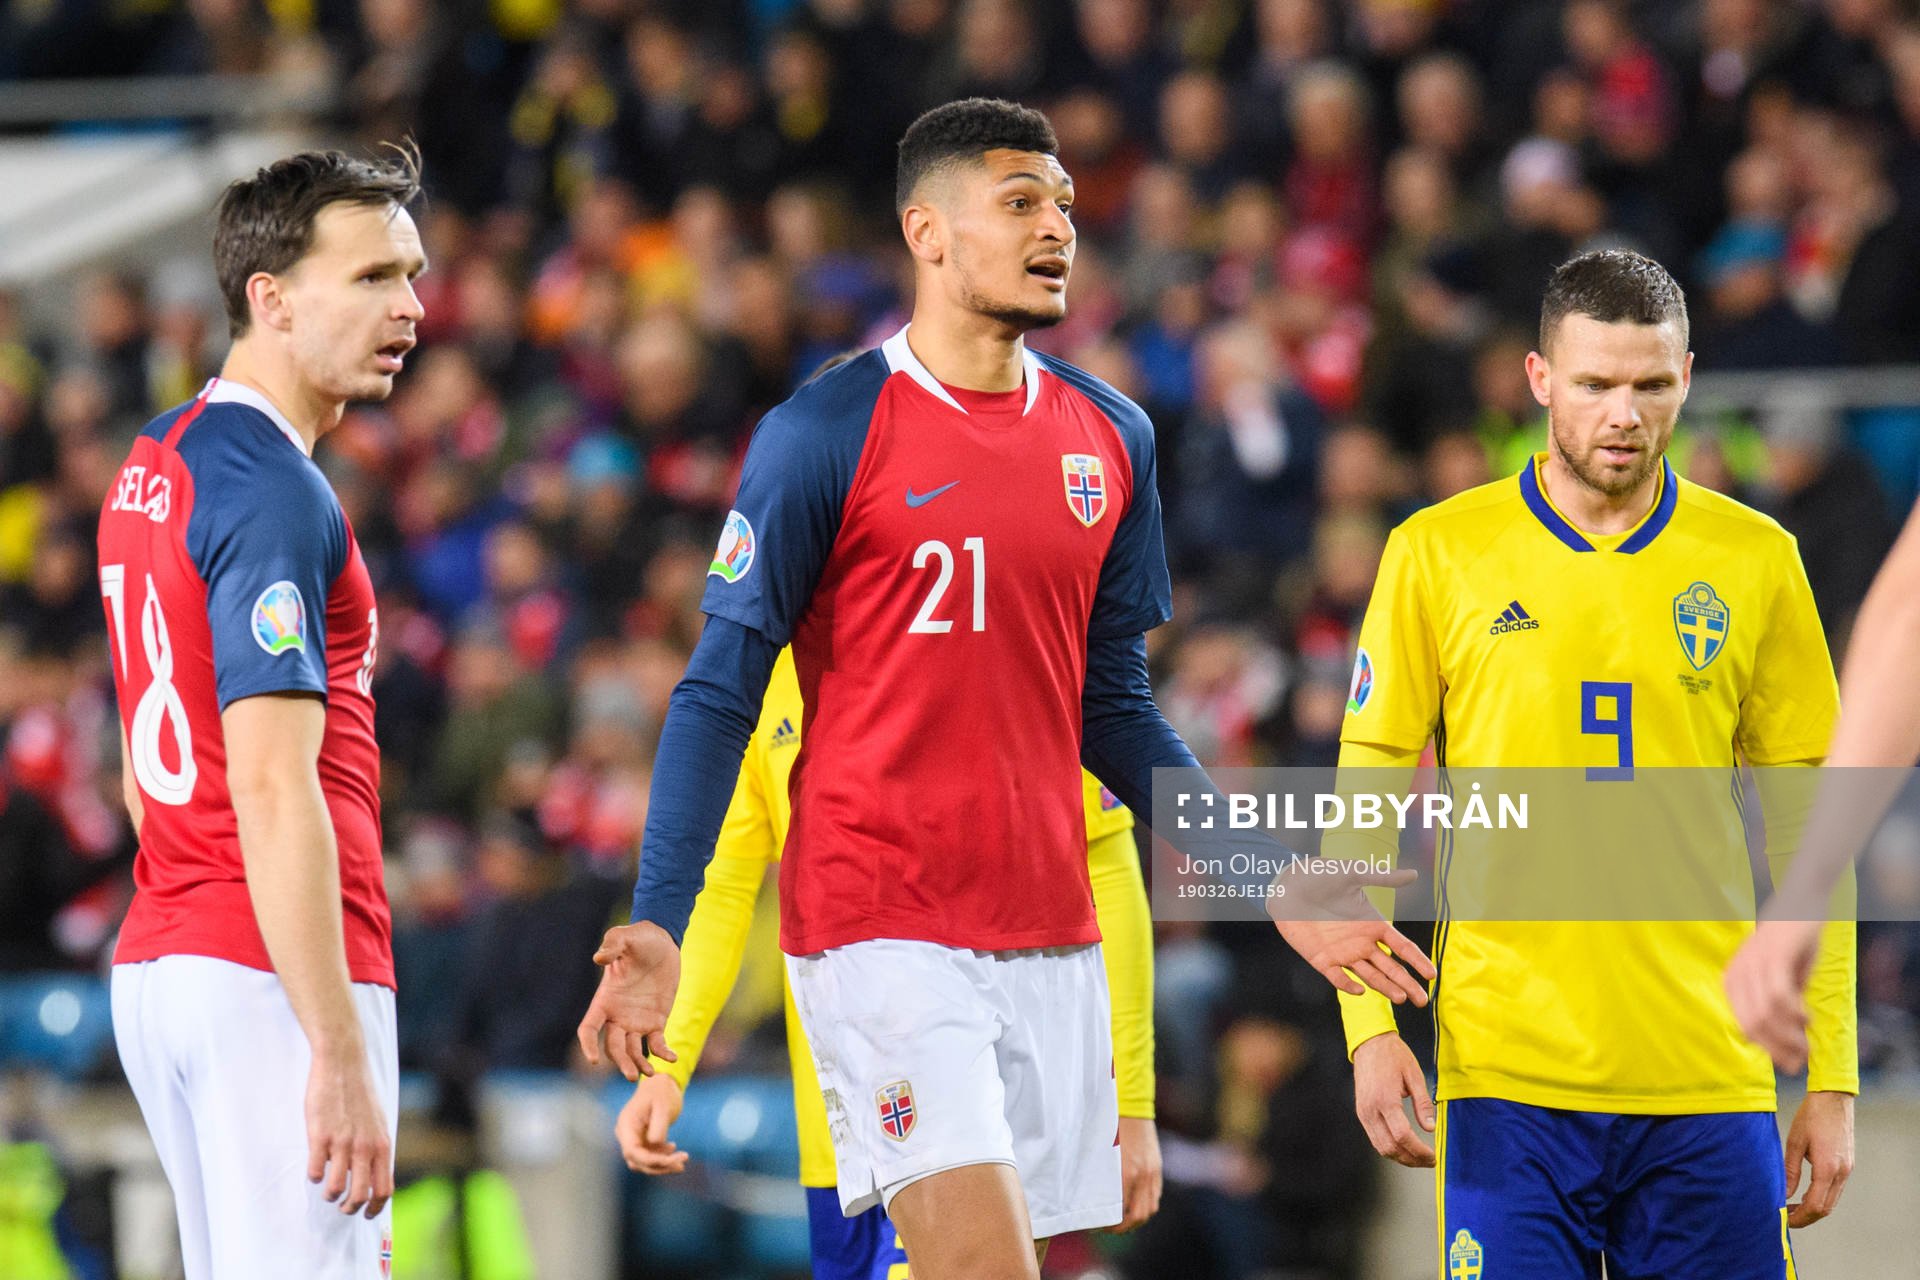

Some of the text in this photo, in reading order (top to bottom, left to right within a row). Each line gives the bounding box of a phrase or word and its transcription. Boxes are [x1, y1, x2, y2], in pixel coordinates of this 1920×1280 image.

[907, 536, 985, 634] 21
[1683, 604, 1720, 618] SVERIGE
[1490, 619, 1540, 636] adidas
[1581, 681, 1634, 782] 9
